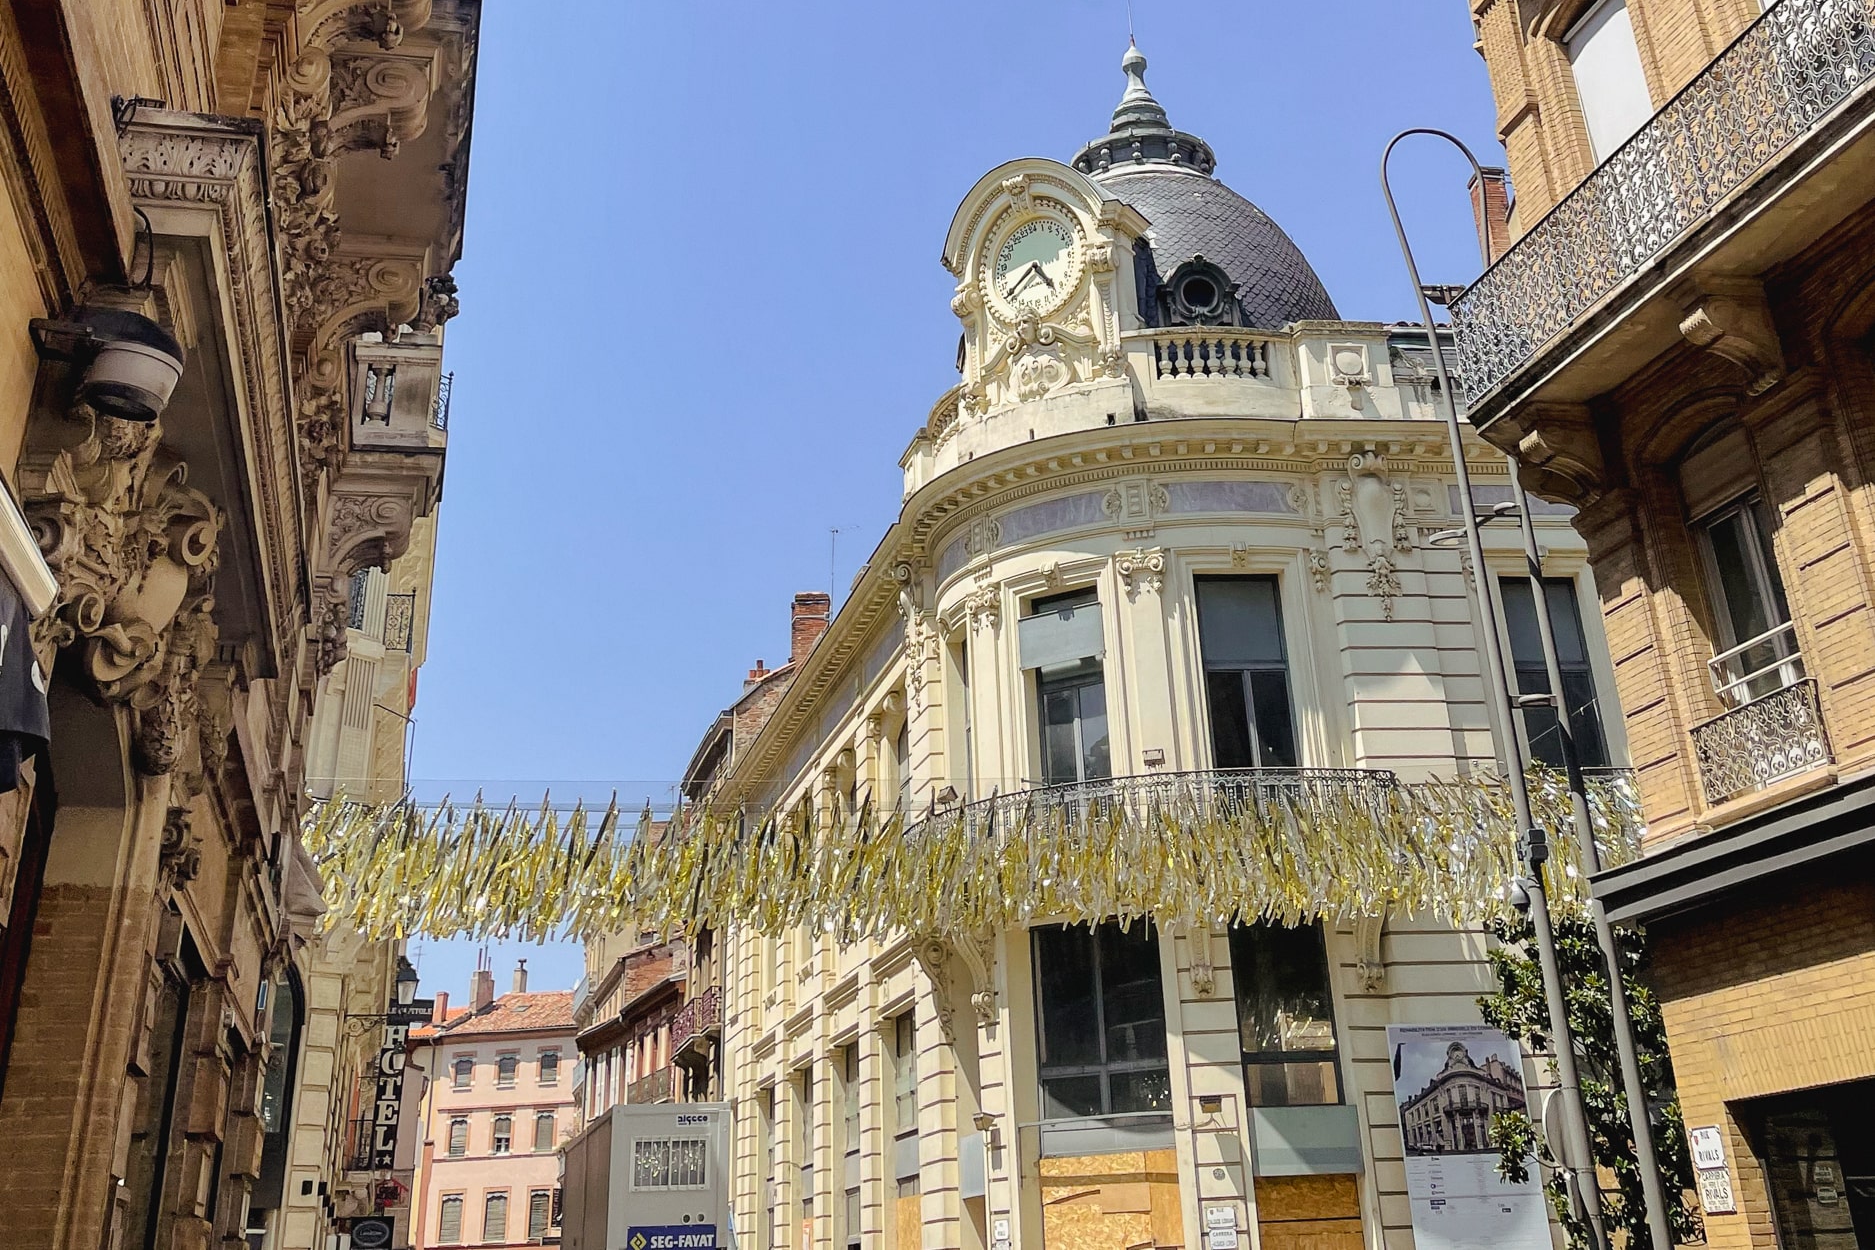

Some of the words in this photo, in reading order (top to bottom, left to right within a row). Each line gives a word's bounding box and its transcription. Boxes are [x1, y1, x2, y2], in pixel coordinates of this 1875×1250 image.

[375, 1025, 408, 1151] HOTEL
[1699, 1150, 1719, 1161] RIVALS
[1705, 1188, 1728, 1200] RIVALS
[650, 1235, 714, 1248] SEG-FAYAT
